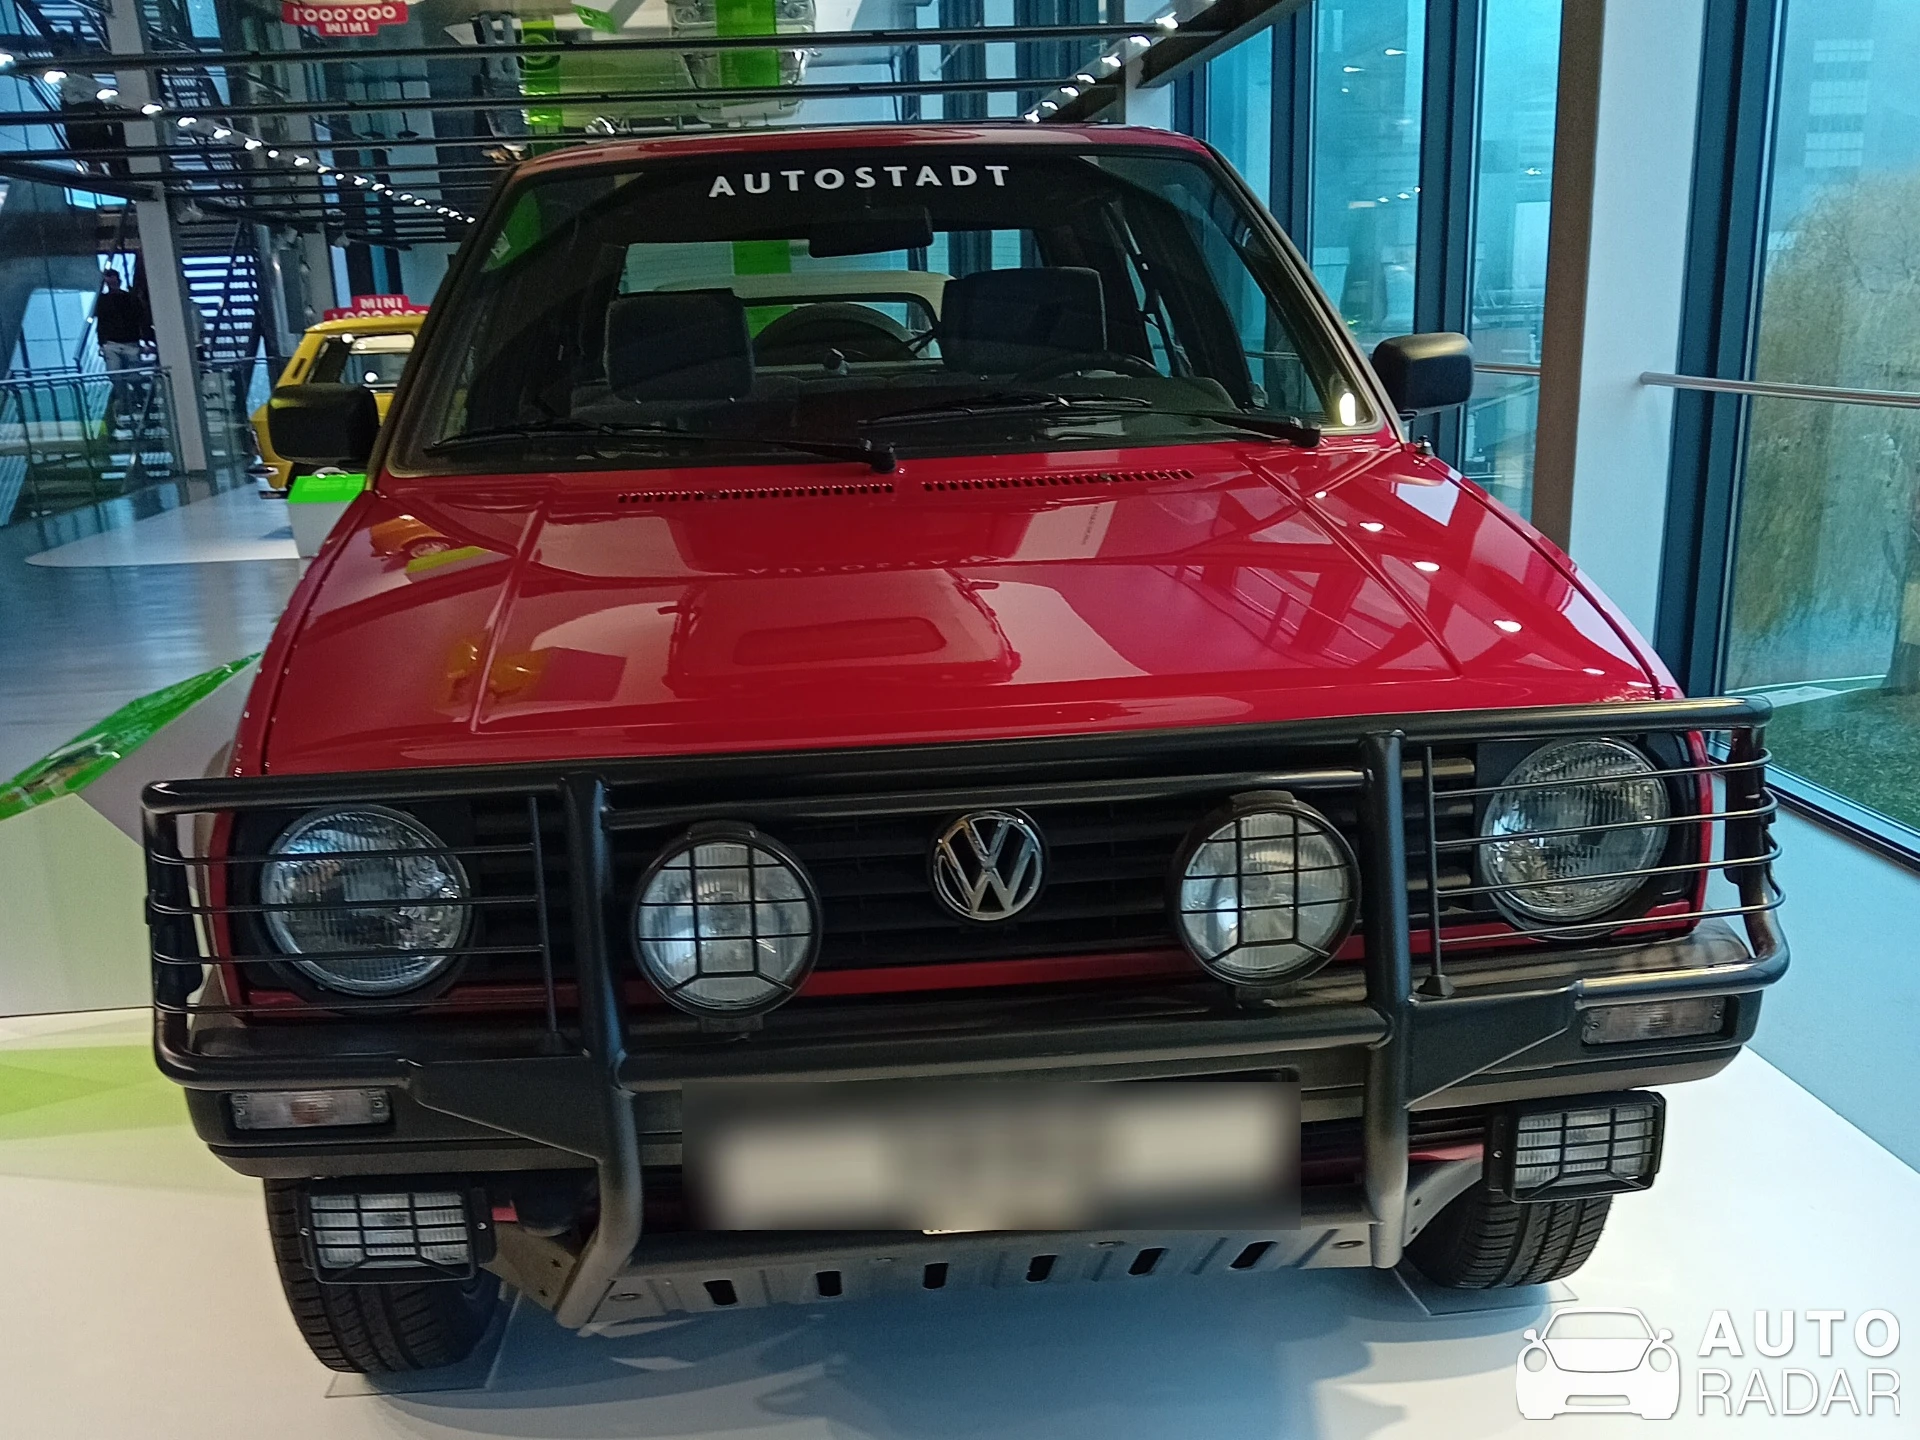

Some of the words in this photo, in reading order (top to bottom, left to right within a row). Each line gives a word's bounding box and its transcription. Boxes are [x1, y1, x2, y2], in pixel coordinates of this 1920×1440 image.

[708, 165, 1010, 198] AUTOSTADT
[360, 297, 403, 309] MINI
[933, 809, 1043, 922] VW
